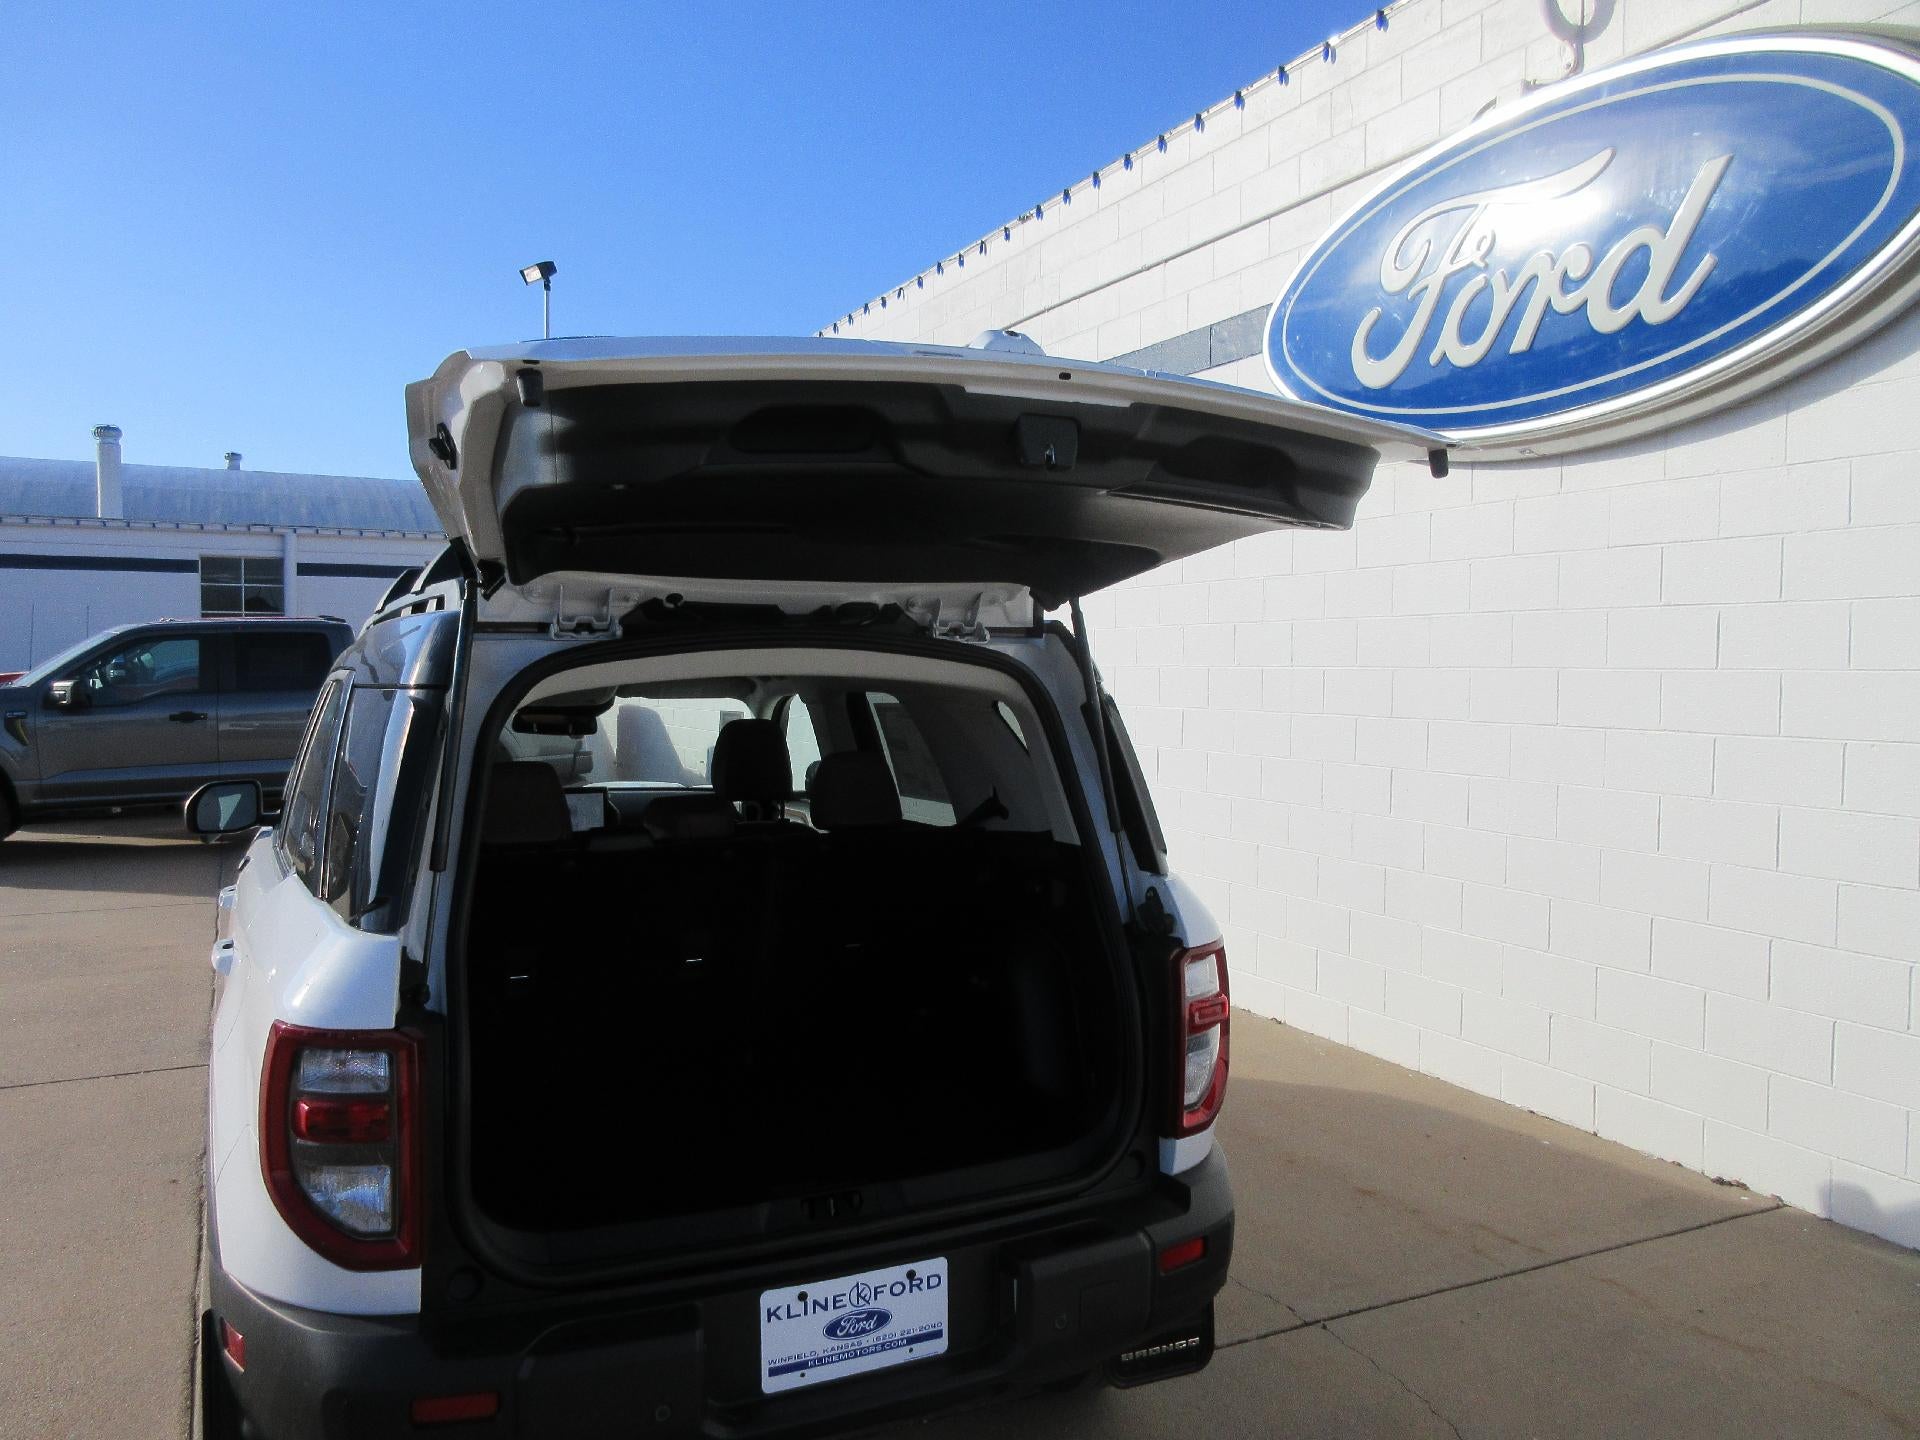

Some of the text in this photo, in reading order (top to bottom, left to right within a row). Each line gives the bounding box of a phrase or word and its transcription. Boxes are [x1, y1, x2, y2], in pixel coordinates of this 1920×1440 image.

[1351, 147, 1734, 390] Ford
[766, 1293, 848, 1323] KLINE
[873, 1273, 942, 1301] FORD
[768, 1350, 820, 1366] WINFIELD,
[823, 1339, 863, 1354] KANSAS
[900, 1321, 943, 1336] 221-2040
[836, 1312, 878, 1336] Ford
[808, 1338, 907, 1368] KLINEMOTORS.COM
